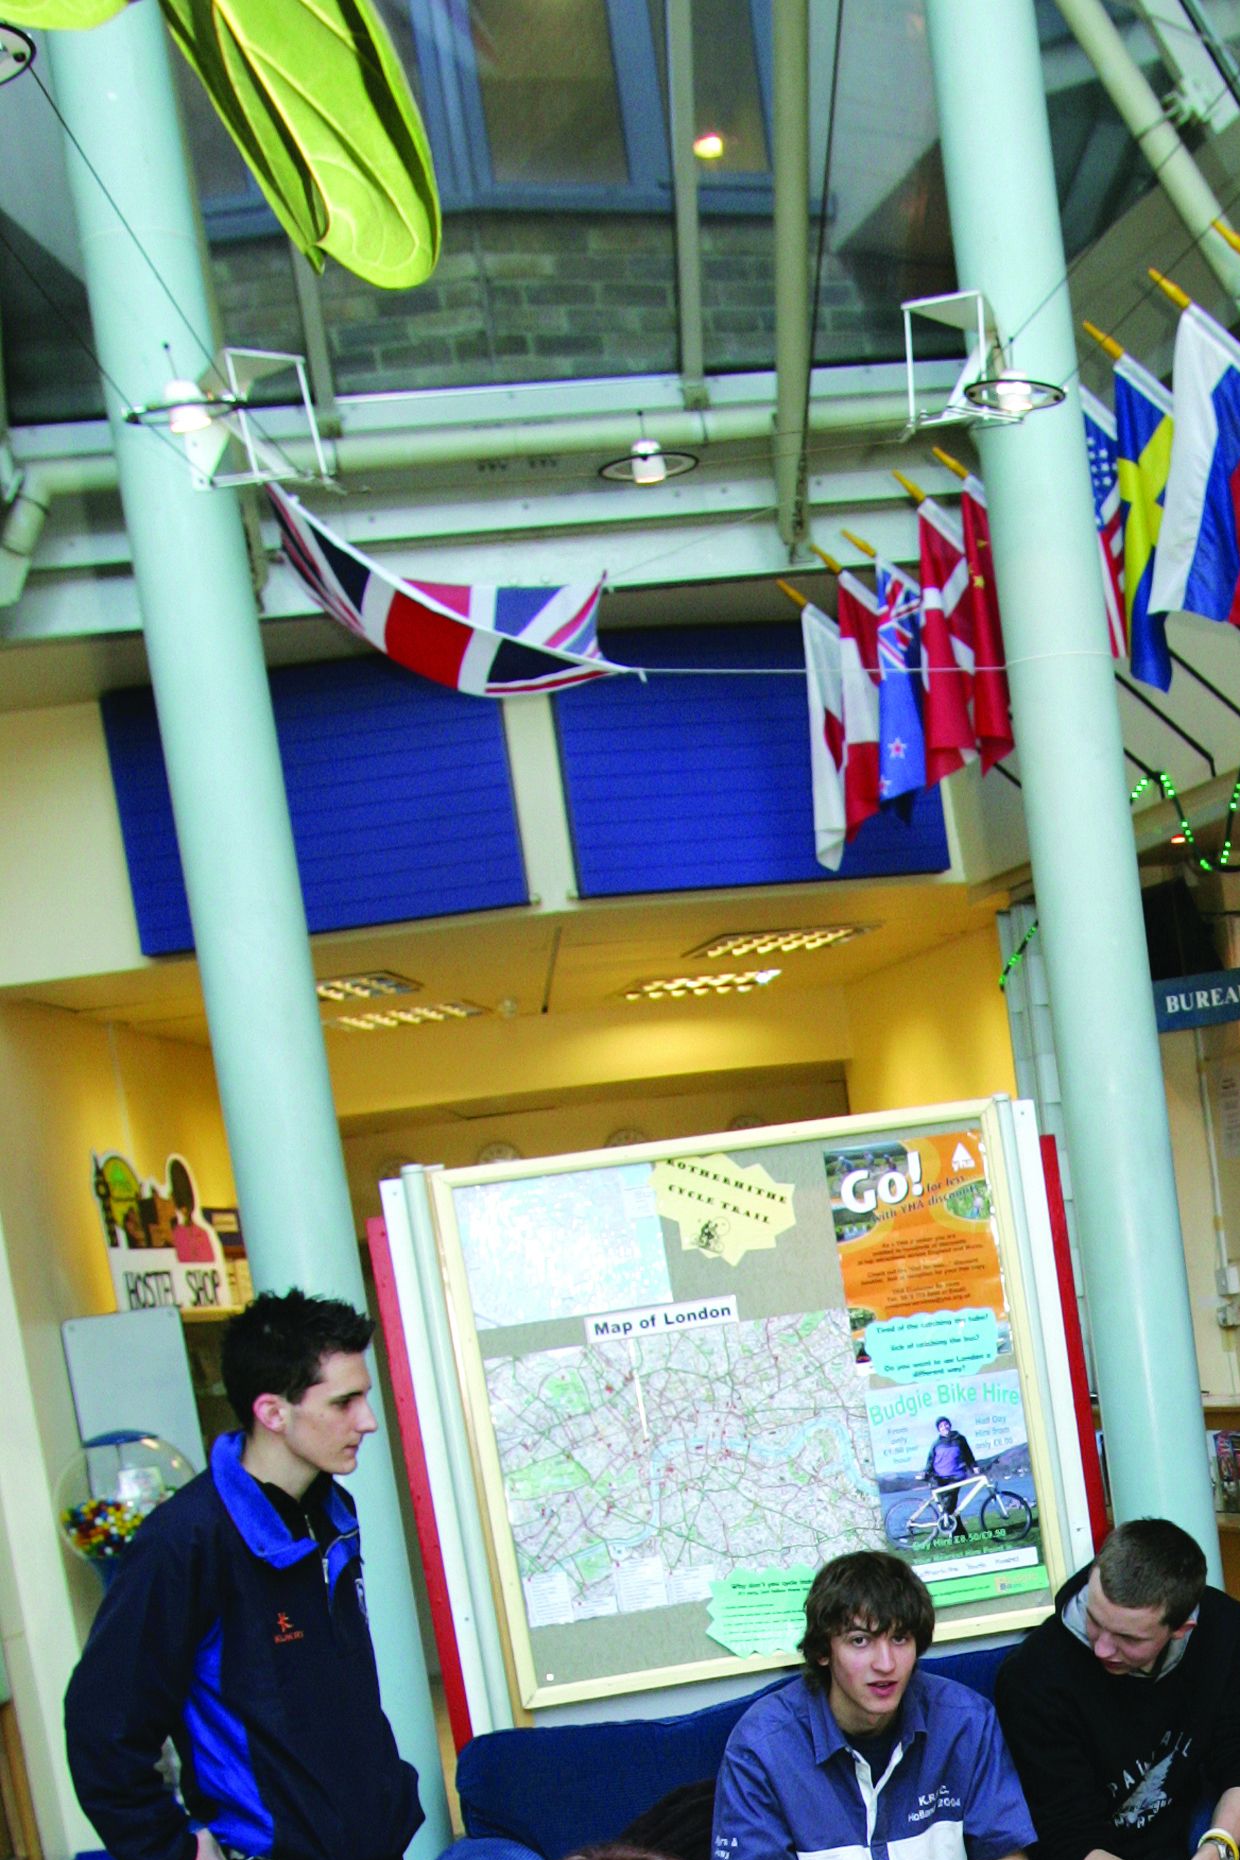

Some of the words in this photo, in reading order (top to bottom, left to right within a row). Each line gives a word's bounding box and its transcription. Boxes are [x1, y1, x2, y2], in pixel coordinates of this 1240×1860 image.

[666, 1159, 787, 1203] ROTHERHITHE
[668, 1184, 715, 1206] CYCLE
[721, 1202, 770, 1224] TRAIL
[902, 1200, 925, 1213] YHA
[124, 1271, 176, 1310] HOSTEL
[186, 1269, 219, 1306] SHOP
[594, 1321, 633, 1336] Map
[640, 1314, 656, 1329] of
[665, 1306, 731, 1325] London
[868, 1393, 932, 1427] Budgie
[936, 1384, 977, 1405] Bike
[983, 1383, 1019, 1406] Hire
